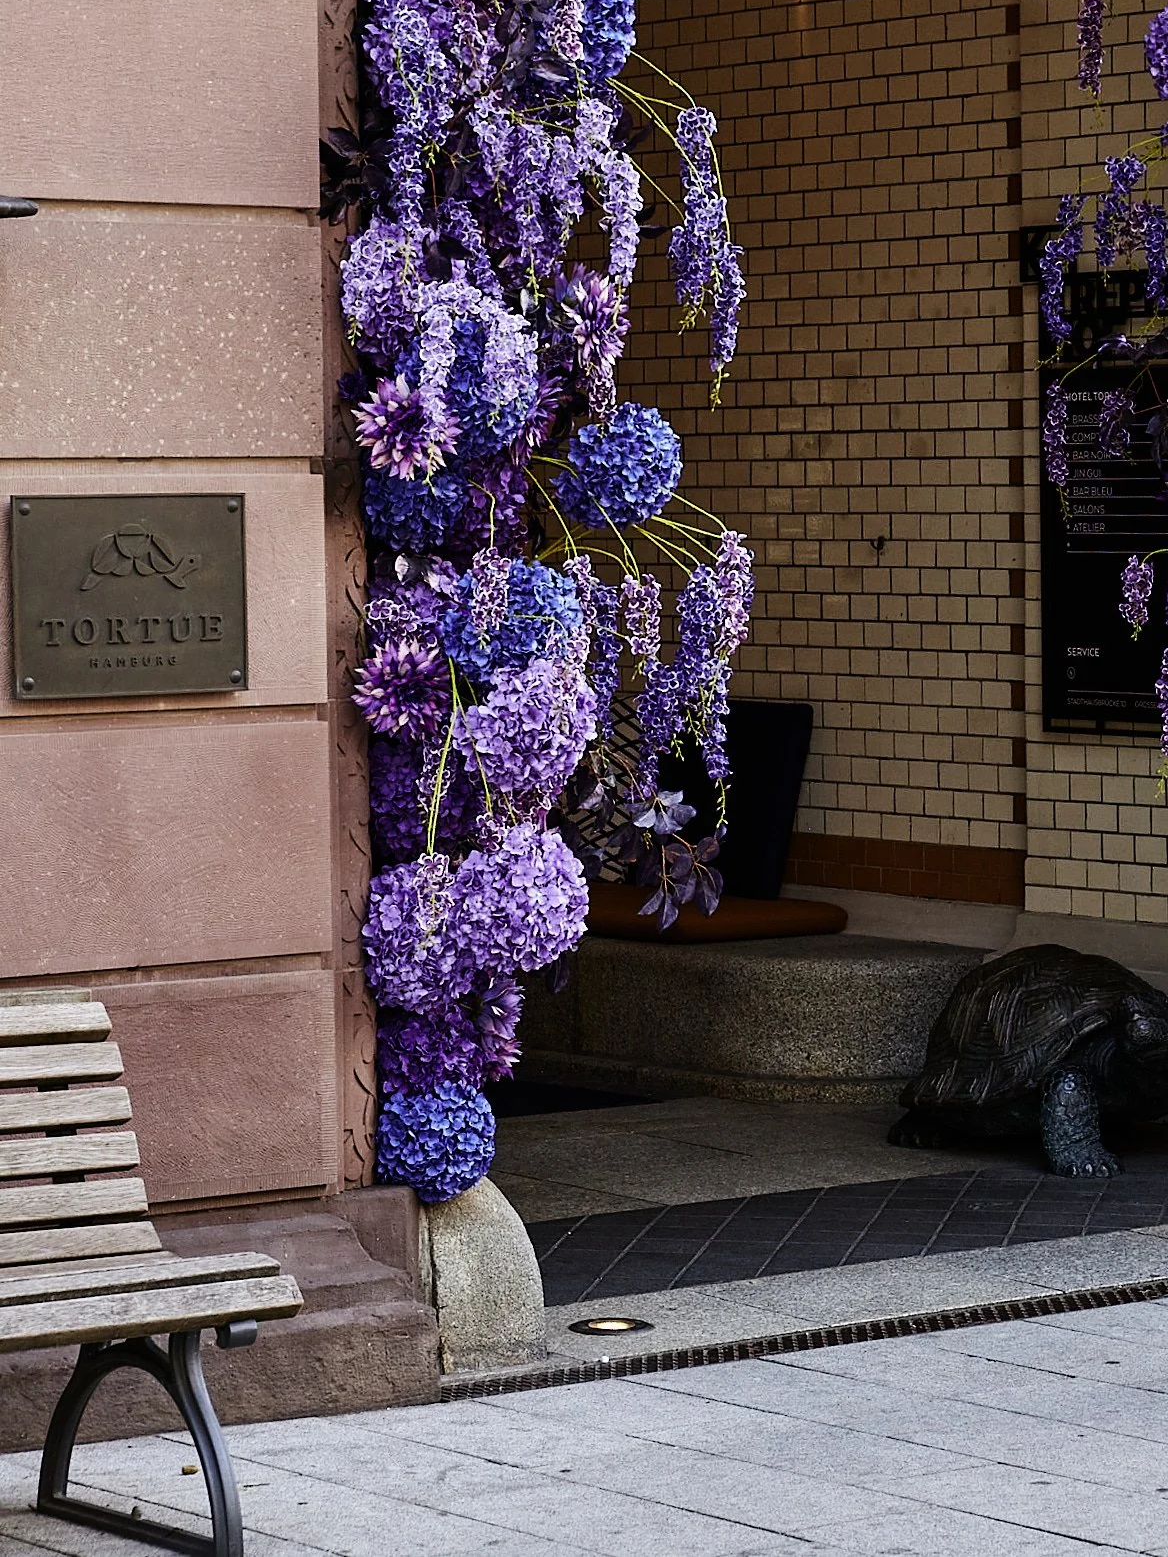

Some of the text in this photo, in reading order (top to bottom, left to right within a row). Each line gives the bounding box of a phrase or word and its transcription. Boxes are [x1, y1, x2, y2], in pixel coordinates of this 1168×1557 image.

[1072, 450, 1089, 460] BAR
[1072, 468, 1086, 478] JIN
[1072, 486, 1113, 496] BAR BLEU
[1072, 504, 1105, 514] SALONS
[1072, 522, 1106, 532] ATELIER
[40, 612, 225, 648] TORTUE
[1066, 647, 1100, 658] SERVICE
[89, 655, 178, 669] HAMBURG
